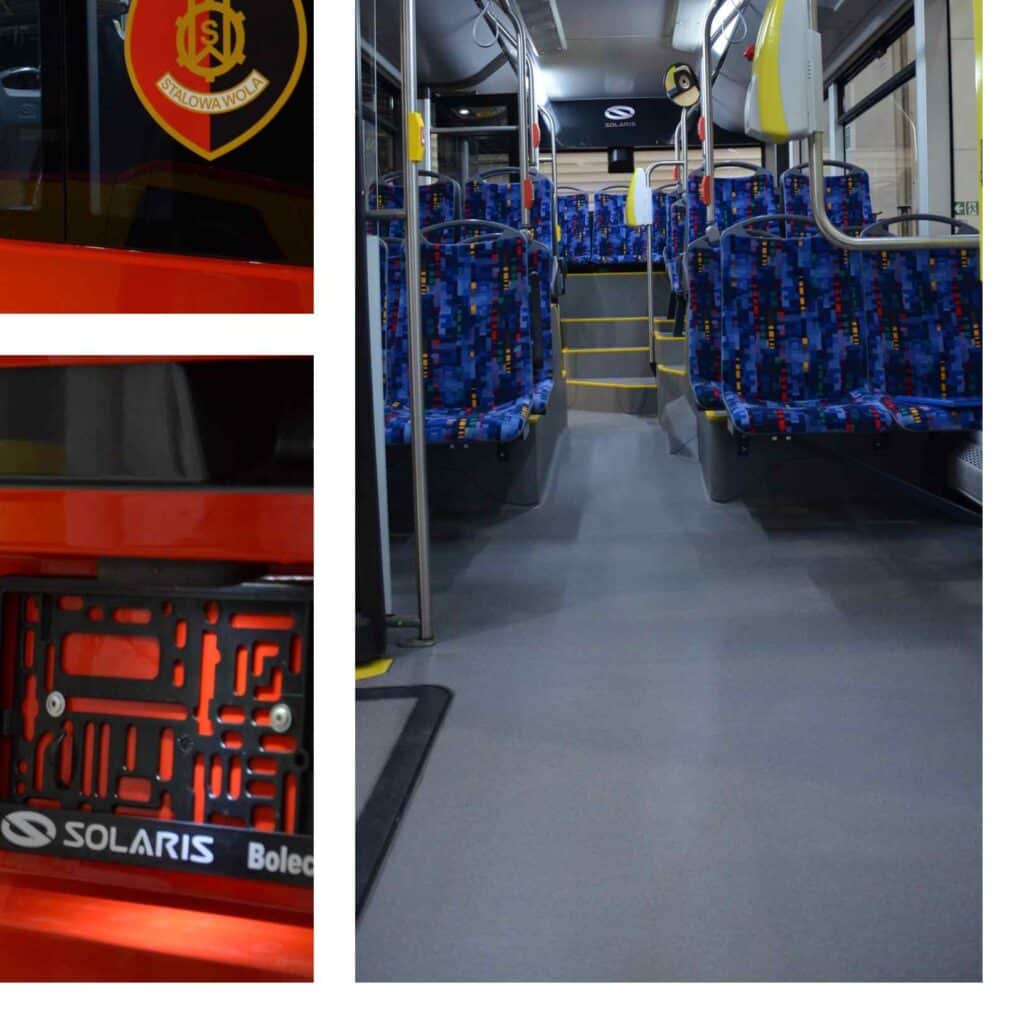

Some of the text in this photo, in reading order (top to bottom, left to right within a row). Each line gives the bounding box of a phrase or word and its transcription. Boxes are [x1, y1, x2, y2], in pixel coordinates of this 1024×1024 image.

[161, 76, 264, 110] STALOWA WOLA
[63, 821, 214, 864] SOLARIS
